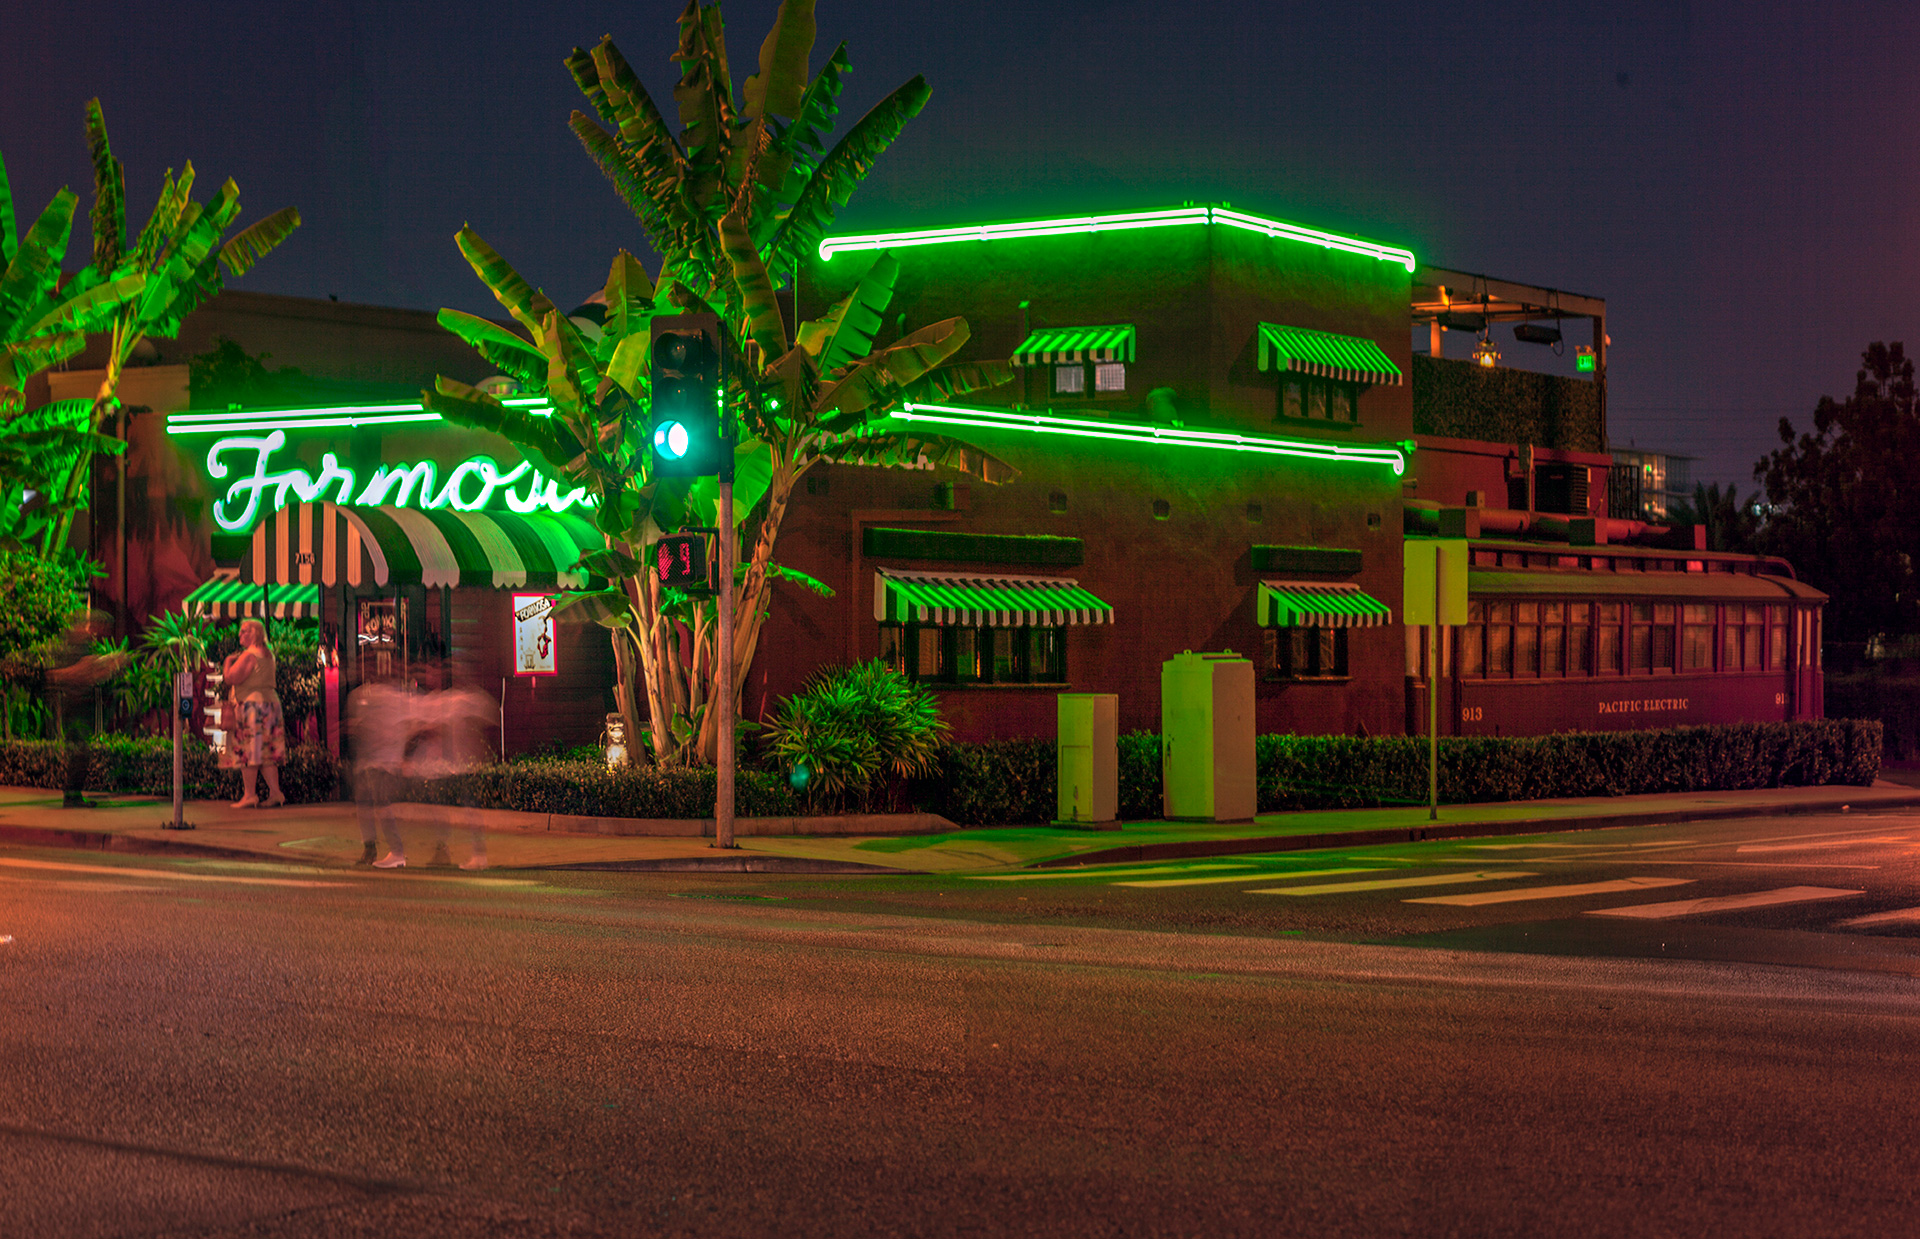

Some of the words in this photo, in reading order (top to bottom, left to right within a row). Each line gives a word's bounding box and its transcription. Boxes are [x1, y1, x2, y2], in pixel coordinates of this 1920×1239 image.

[294, 552, 316, 566] 7156
[519, 597, 552, 621] FORMOSA
[1462, 706, 1483, 722] 913
[1599, 700, 1641, 714] PACIFIC
[1643, 698, 1689, 712] ELECTRIC
